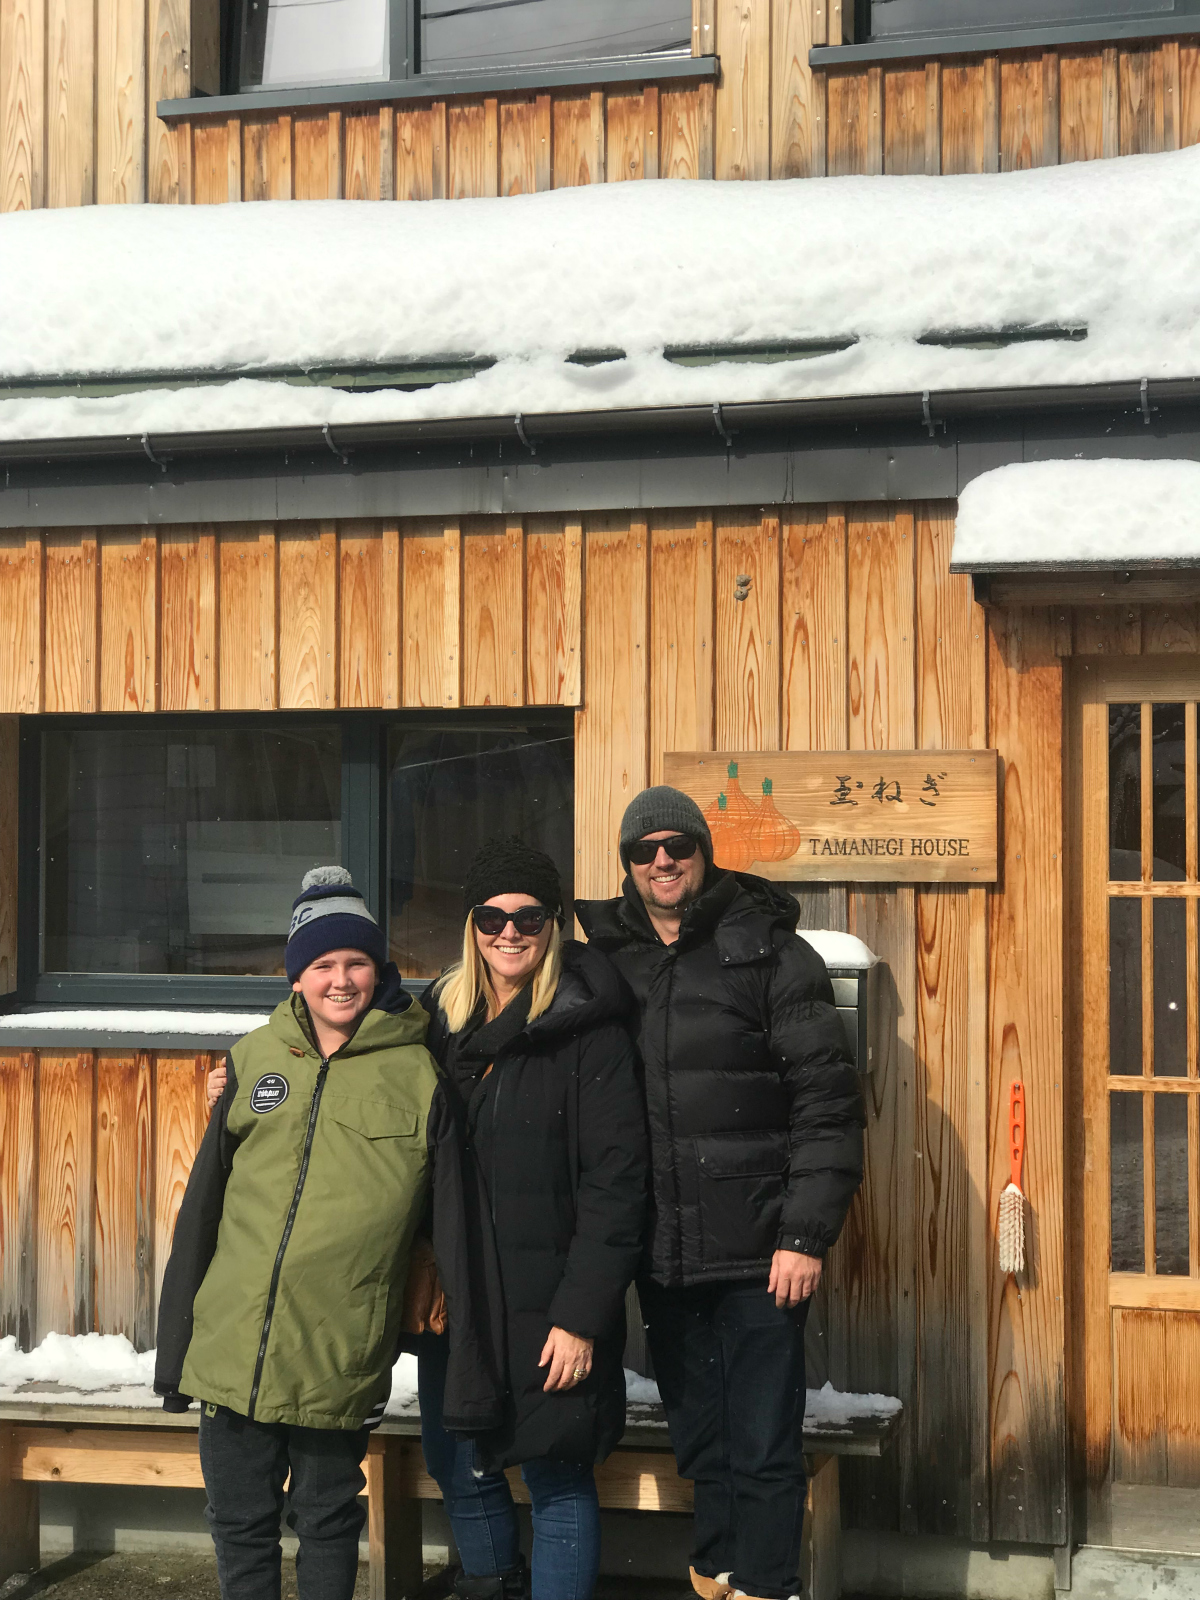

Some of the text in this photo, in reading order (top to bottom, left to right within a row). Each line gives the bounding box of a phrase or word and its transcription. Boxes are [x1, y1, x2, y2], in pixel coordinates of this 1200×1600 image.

[829, 771, 948, 807] 玉ねぎ
[809, 838, 970, 857] TAMANEGI HOUSE
